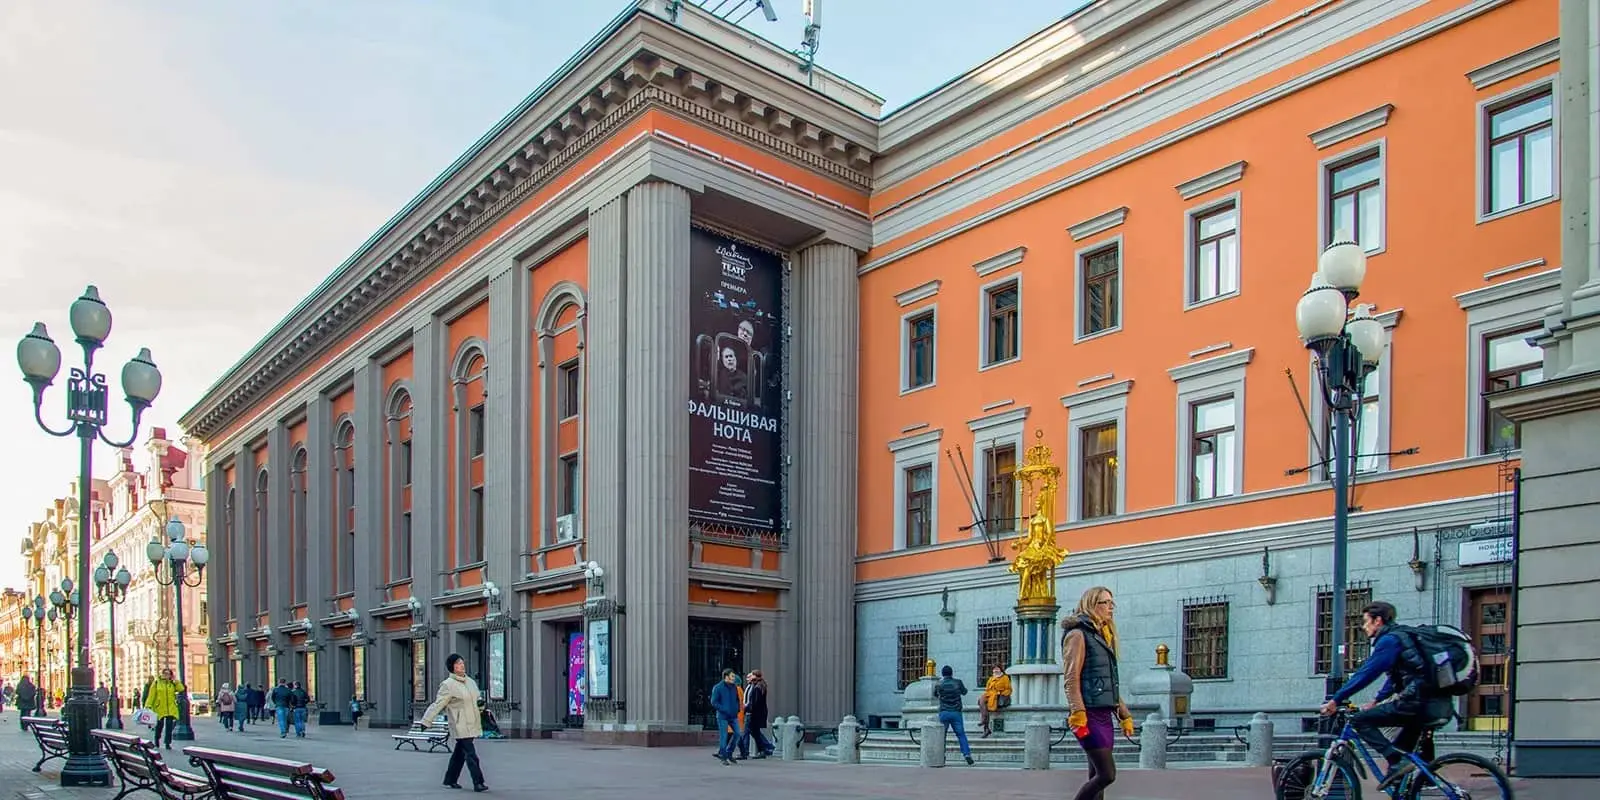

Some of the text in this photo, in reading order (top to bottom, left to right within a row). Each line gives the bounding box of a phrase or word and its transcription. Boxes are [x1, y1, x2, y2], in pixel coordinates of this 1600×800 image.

[721, 262, 746, 275] ТЕАТР
[688, 400, 777, 432] ФАЛЬШИВАЯ
[713, 422, 752, 443] НОТА
